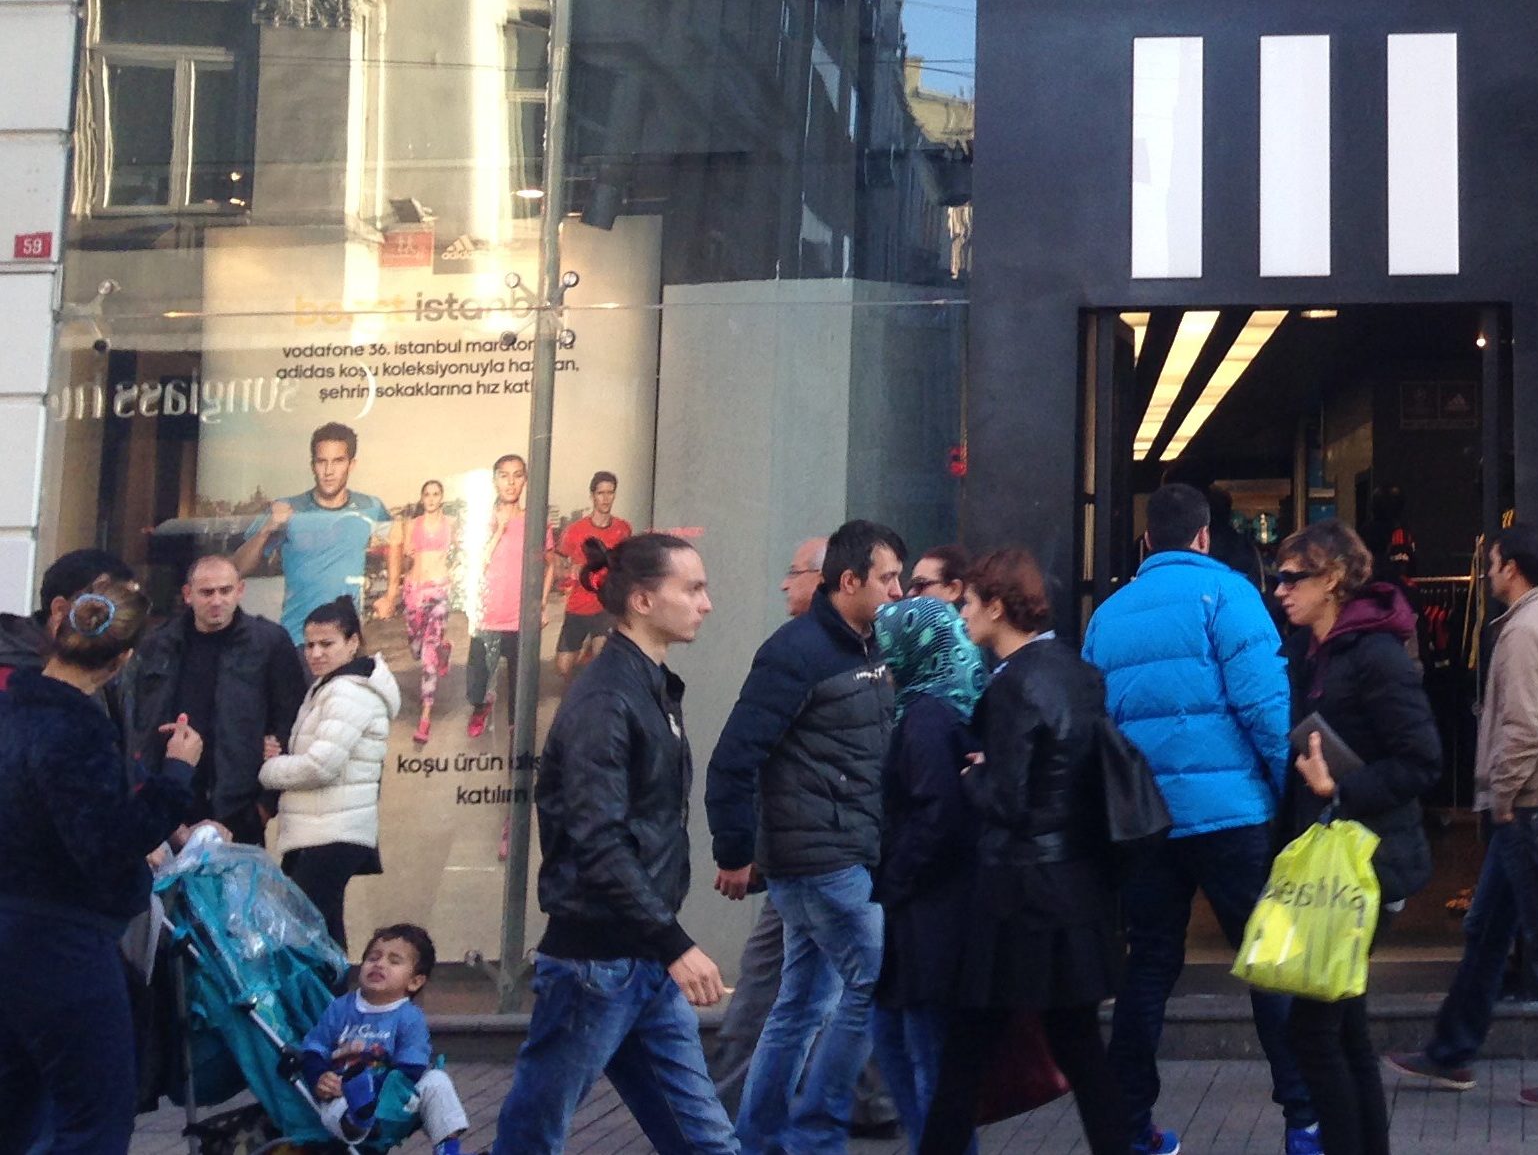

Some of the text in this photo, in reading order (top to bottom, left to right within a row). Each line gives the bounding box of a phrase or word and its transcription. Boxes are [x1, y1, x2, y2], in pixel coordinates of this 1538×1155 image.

[283, 343, 365, 358] vodafone
[369, 343, 391, 356] 36.
[394, 339, 461, 355] istanbul
[276, 363, 335, 379] adidas
[383, 359, 505, 378] koleksiyonuyla
[376, 380, 472, 398] sokaklarına
[476, 380, 500, 395] hız
[397, 754, 448, 778] koşu
[454, 752, 503, 771] ürün
